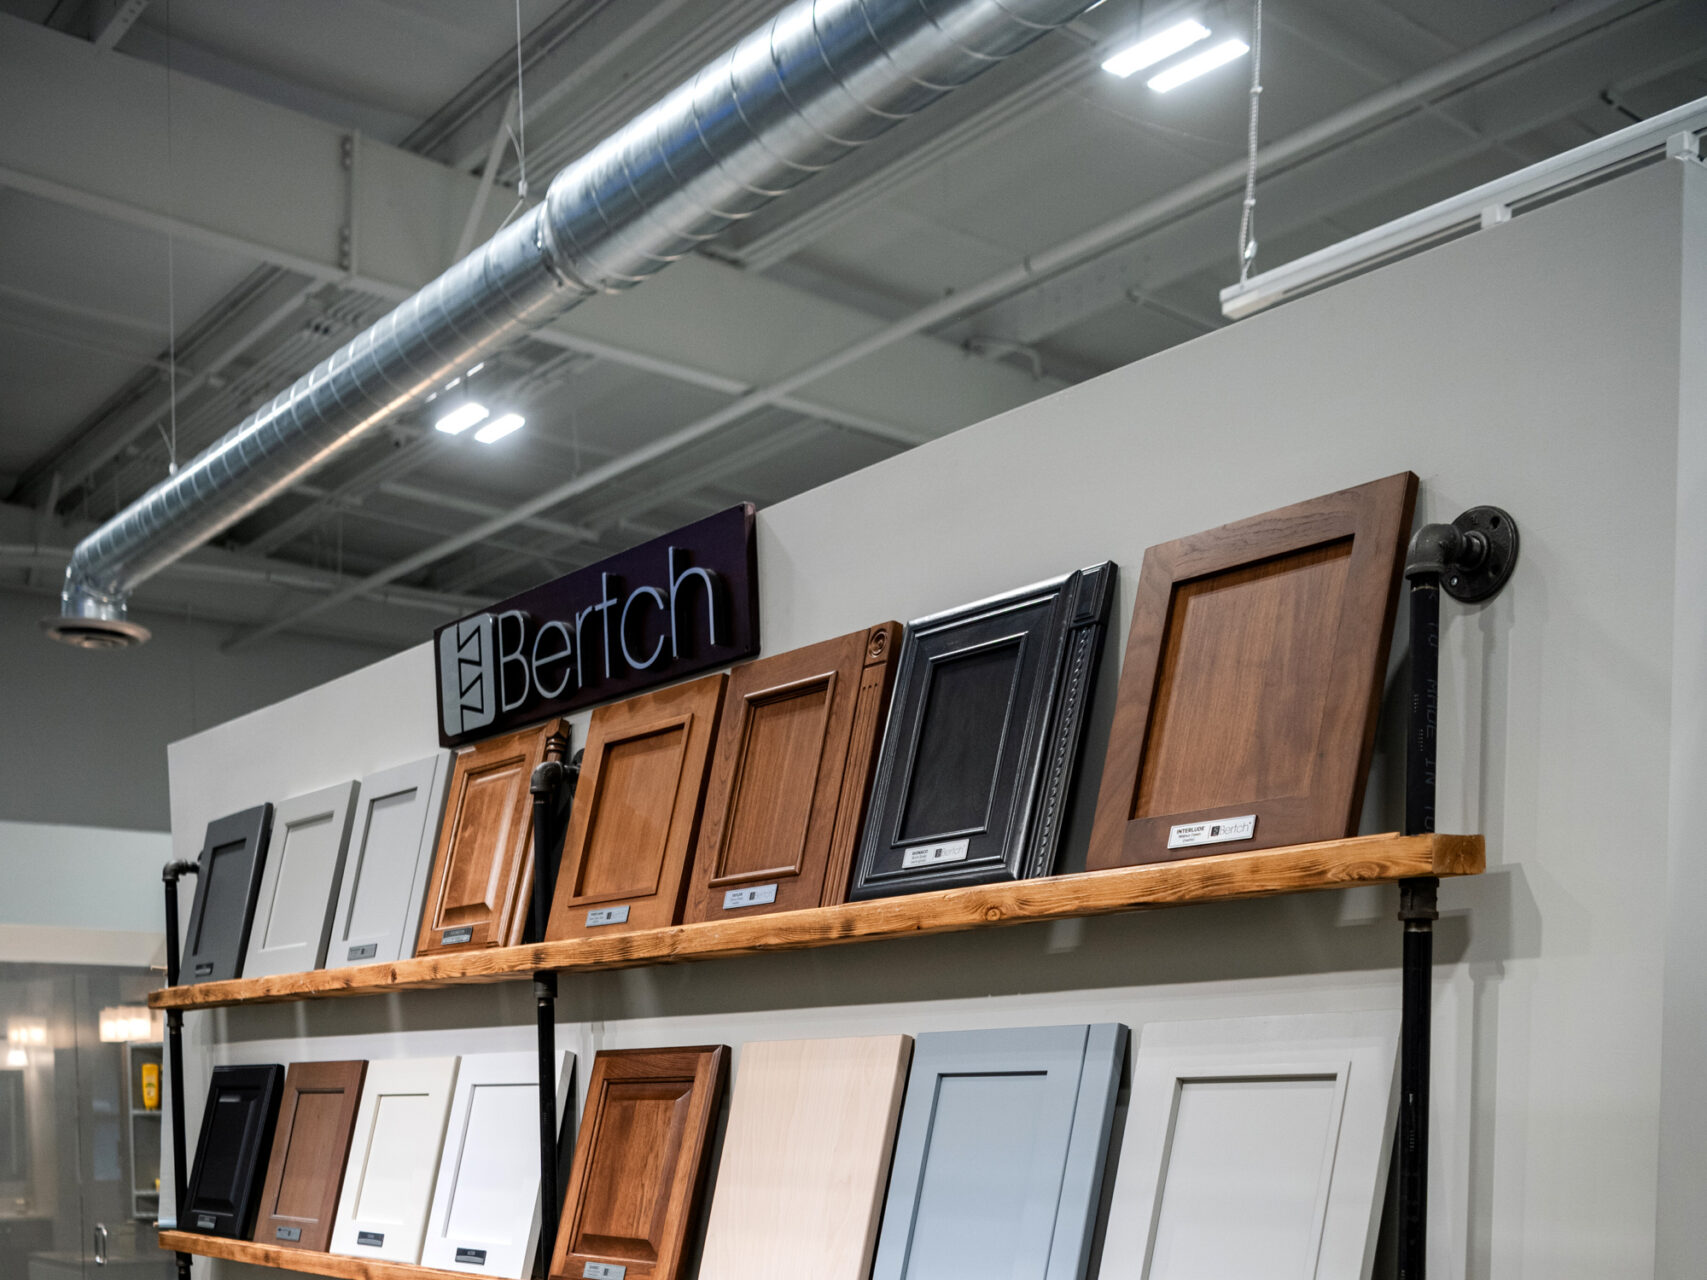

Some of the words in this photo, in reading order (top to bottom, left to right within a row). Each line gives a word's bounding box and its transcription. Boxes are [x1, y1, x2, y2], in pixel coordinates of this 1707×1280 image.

[499, 546, 716, 713] Bertch
[1177, 825, 1205, 835] INTERLUDE
[1218, 821, 1250, 836] Bertch
